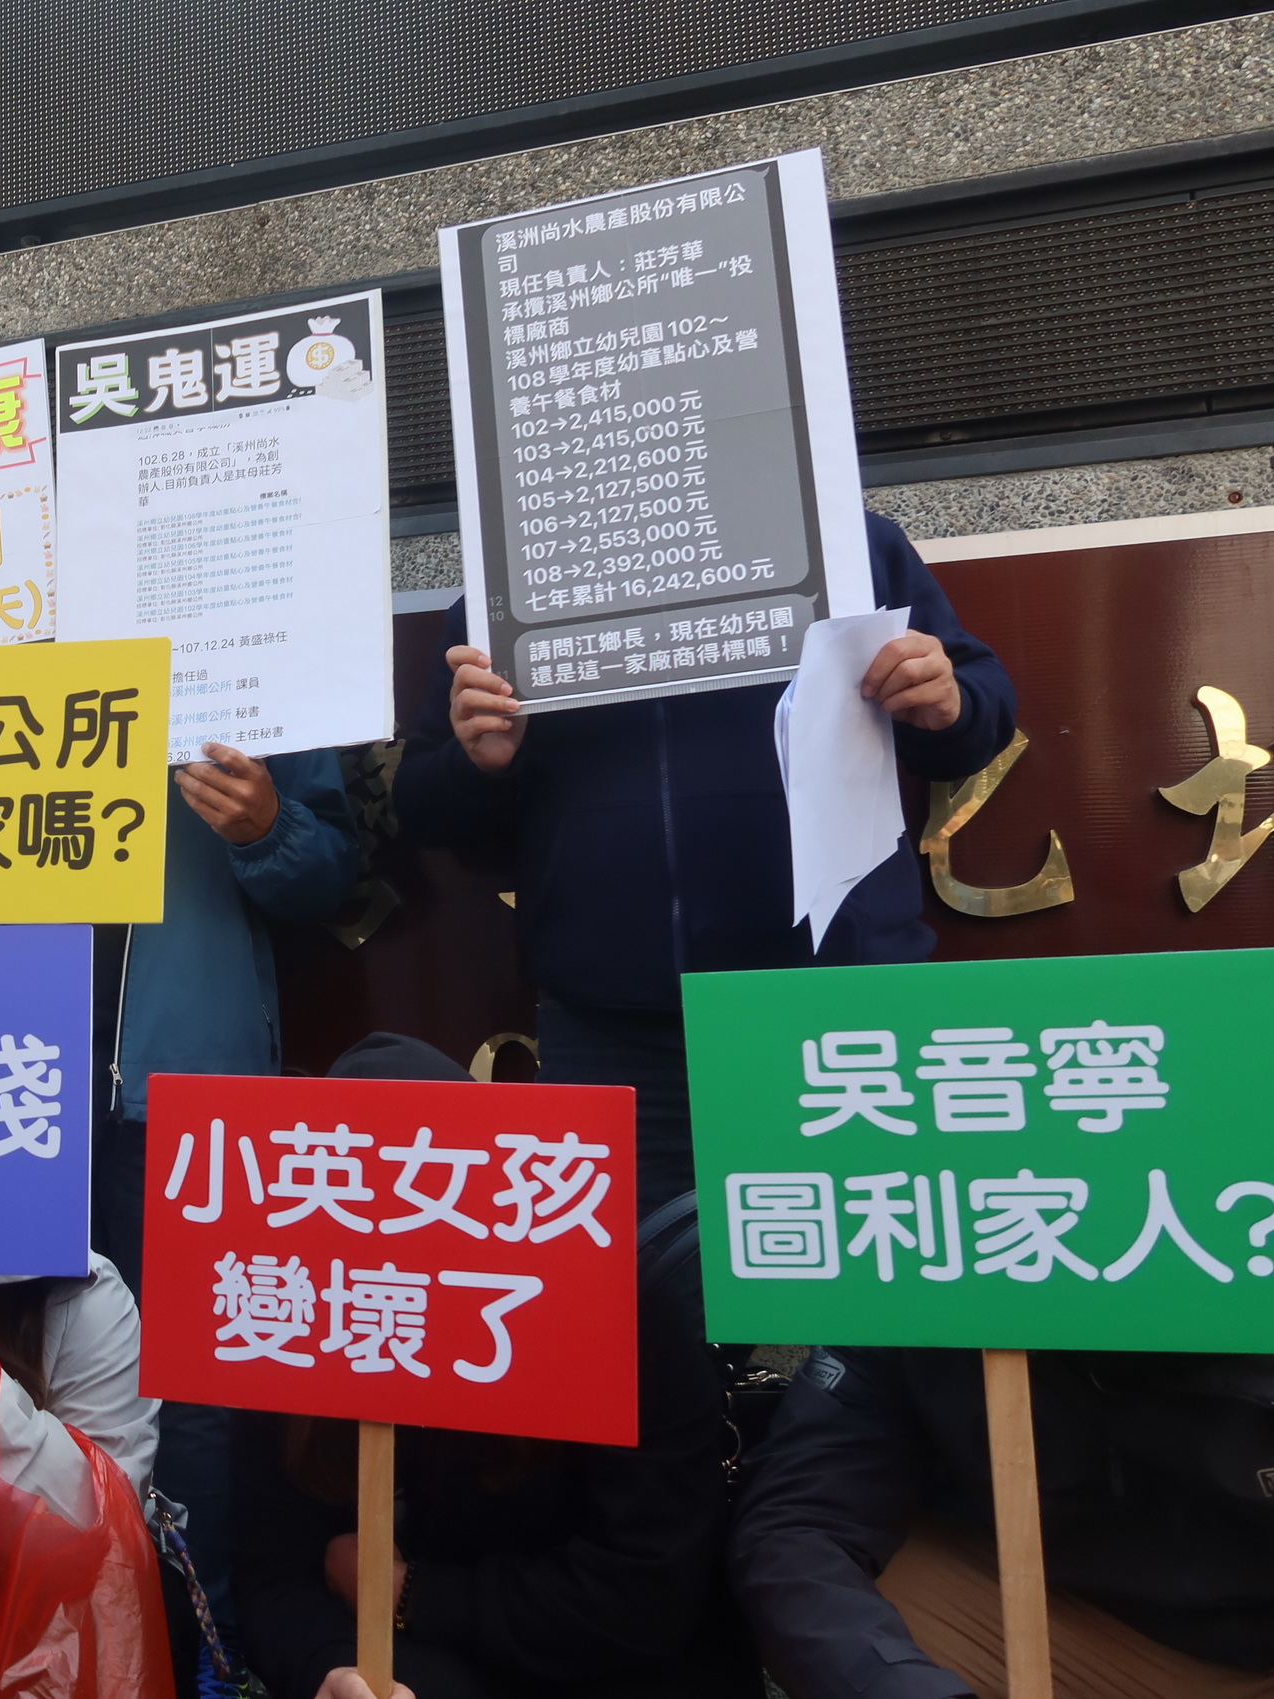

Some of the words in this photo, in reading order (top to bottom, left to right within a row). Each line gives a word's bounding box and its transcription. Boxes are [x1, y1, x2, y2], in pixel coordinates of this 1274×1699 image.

[495, 181, 747, 253] 溪洲尚水農產股份有限公
[497, 254, 519, 275] 司
[503, 316, 570, 347] 標廠商
[69, 330, 281, 425] 吳鬼運
[509, 378, 623, 418] 養午餐食材
[138, 495, 150, 508] 華
[528, 605, 794, 664] 請問江鄉長，現在幼兒園
[530, 634, 788, 688] 還是這一家廠商得標嗎！
[169, 680, 232, 698] 溪州鄉公所
[168, 708, 232, 726] 溪州鄉公所
[235, 705, 260, 720] 秘書
[168, 731, 232, 749] 溪州鄉公所
[235, 725, 284, 743] 主任秘書
[797, 1019, 1170, 1138] 吳音寧
[163, 1117, 612, 1248] 小英女孩
[212, 1250, 544, 1384] 變壞了
